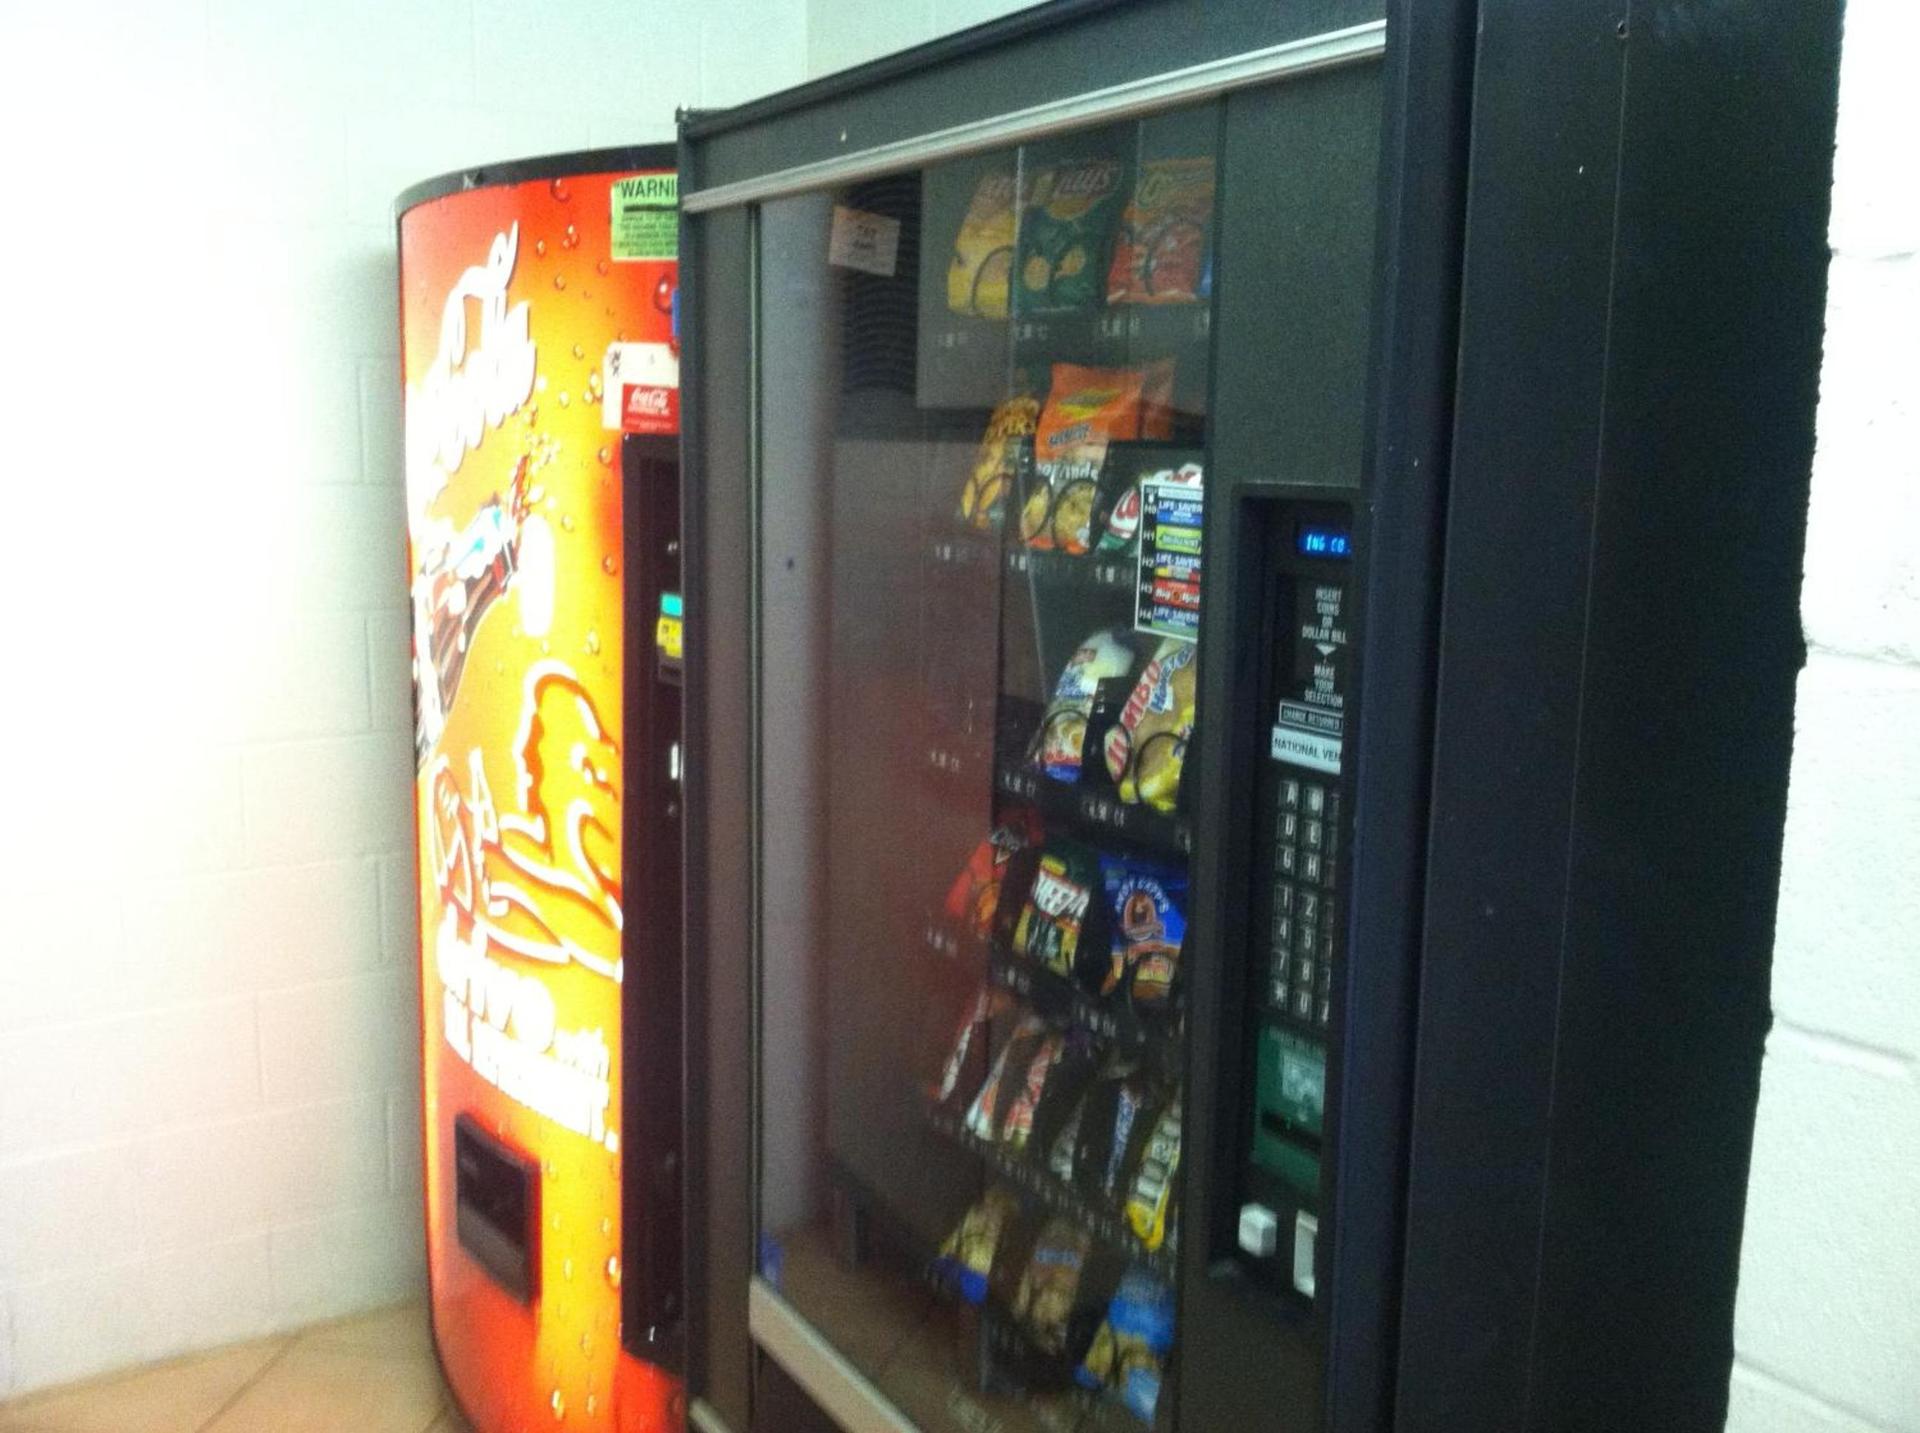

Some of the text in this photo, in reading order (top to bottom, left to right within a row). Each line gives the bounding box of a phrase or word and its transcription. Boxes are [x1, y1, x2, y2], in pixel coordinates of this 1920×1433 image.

[1302, 626, 1329, 640] DOLLAR
[1304, 690, 1343, 708] SELECTION
[1274, 737, 1320, 758] NATIONAL
